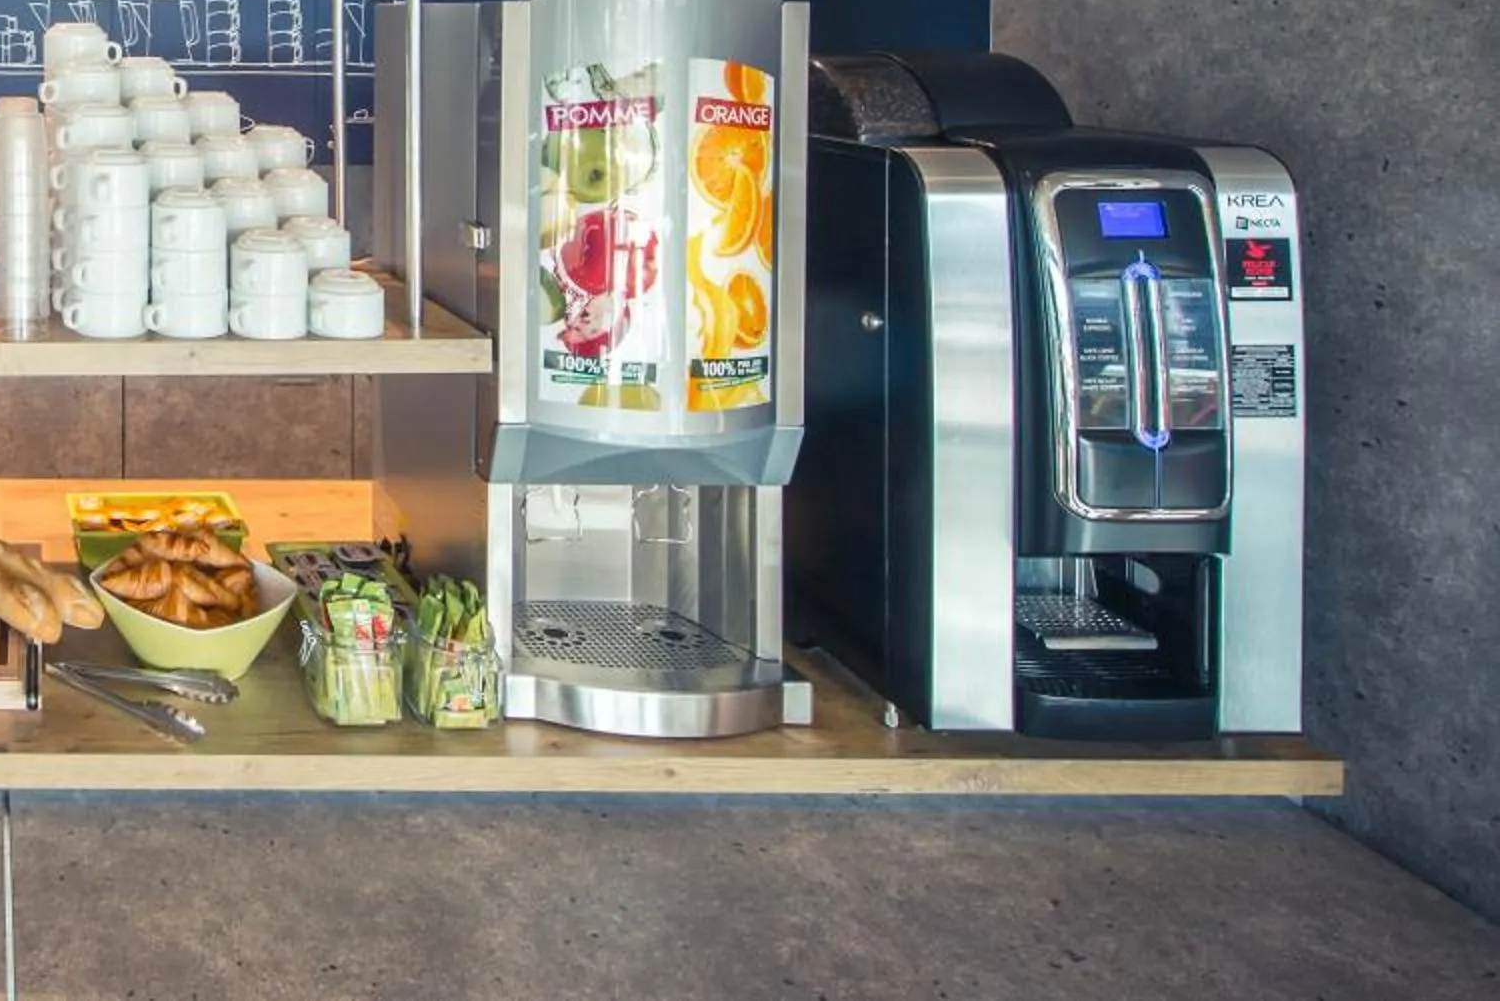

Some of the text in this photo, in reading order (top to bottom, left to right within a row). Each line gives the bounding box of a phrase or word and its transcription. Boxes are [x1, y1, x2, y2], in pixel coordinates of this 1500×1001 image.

[551, 102, 649, 126] POMME
[700, 105, 769, 126] ORANGE
[1227, 194, 1284, 207] KREA
[558, 354, 601, 374] 100%
[702, 360, 737, 376] 100%
